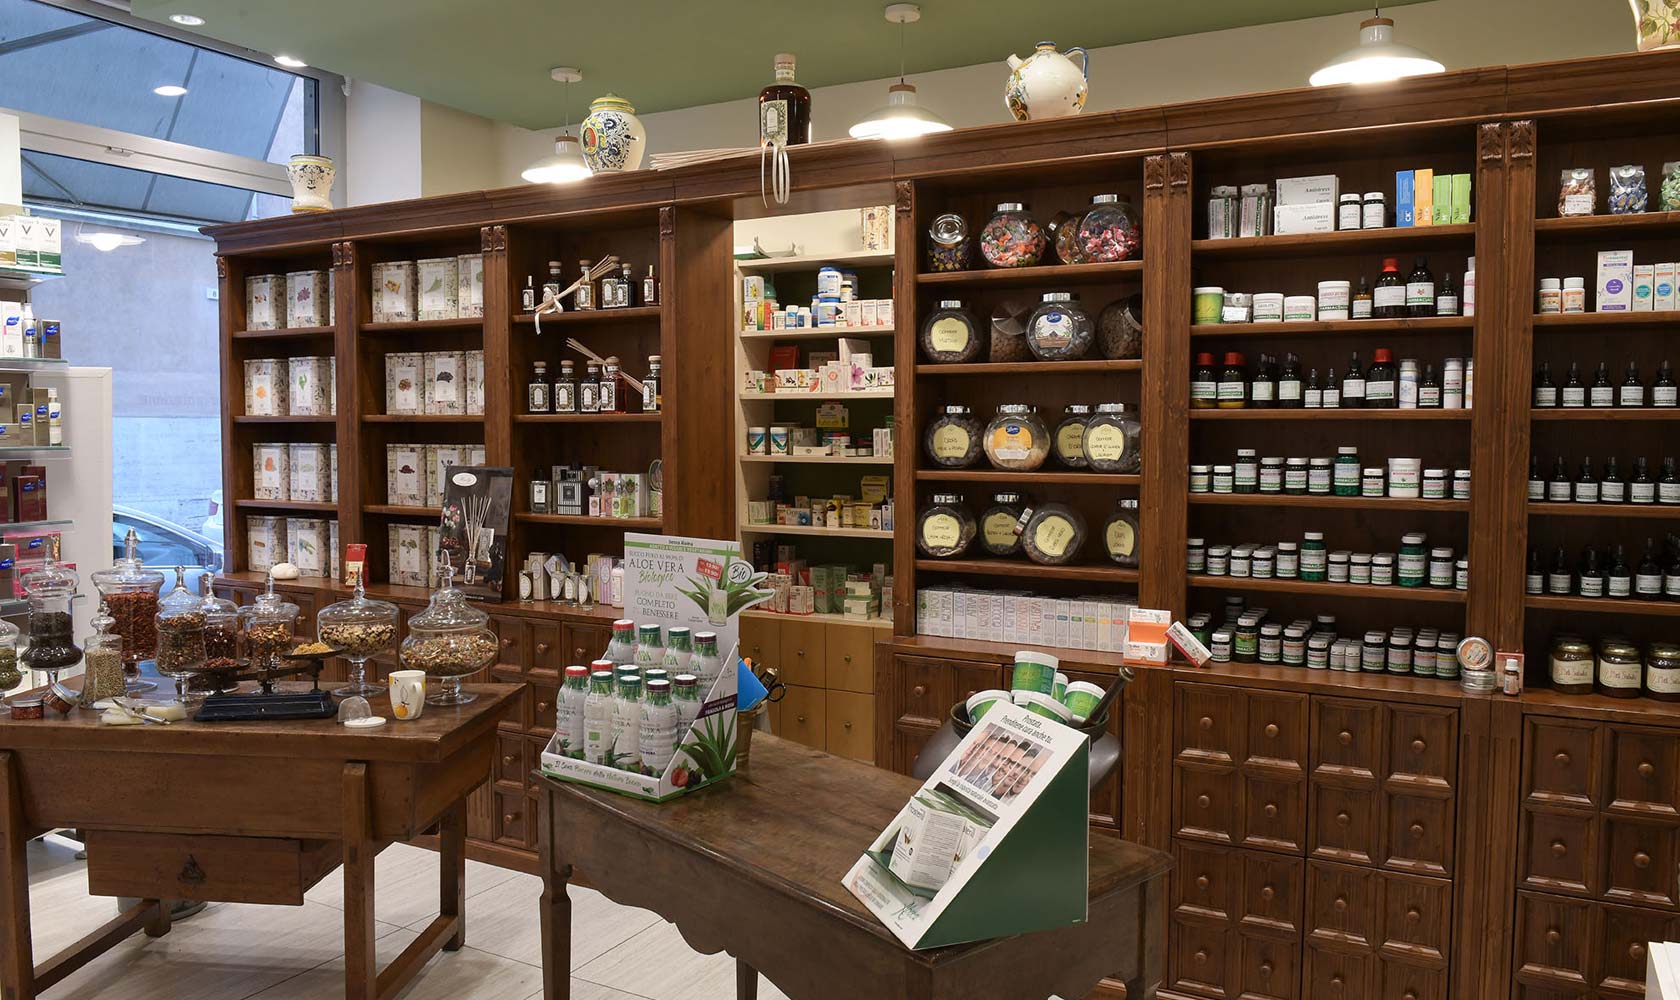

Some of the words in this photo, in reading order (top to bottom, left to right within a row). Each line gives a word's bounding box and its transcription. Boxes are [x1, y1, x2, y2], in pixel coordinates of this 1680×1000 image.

[629, 558, 655, 569] ALOE
[658, 561, 685, 573] VERA
[639, 570, 674, 587] Biologico
[731, 565, 746, 580] Bio
[636, 597, 676, 609] COMPLETO
[642, 608, 679, 620] BENESSERE
[1031, 729, 1047, 741] anche
[593, 769, 605, 778] della
